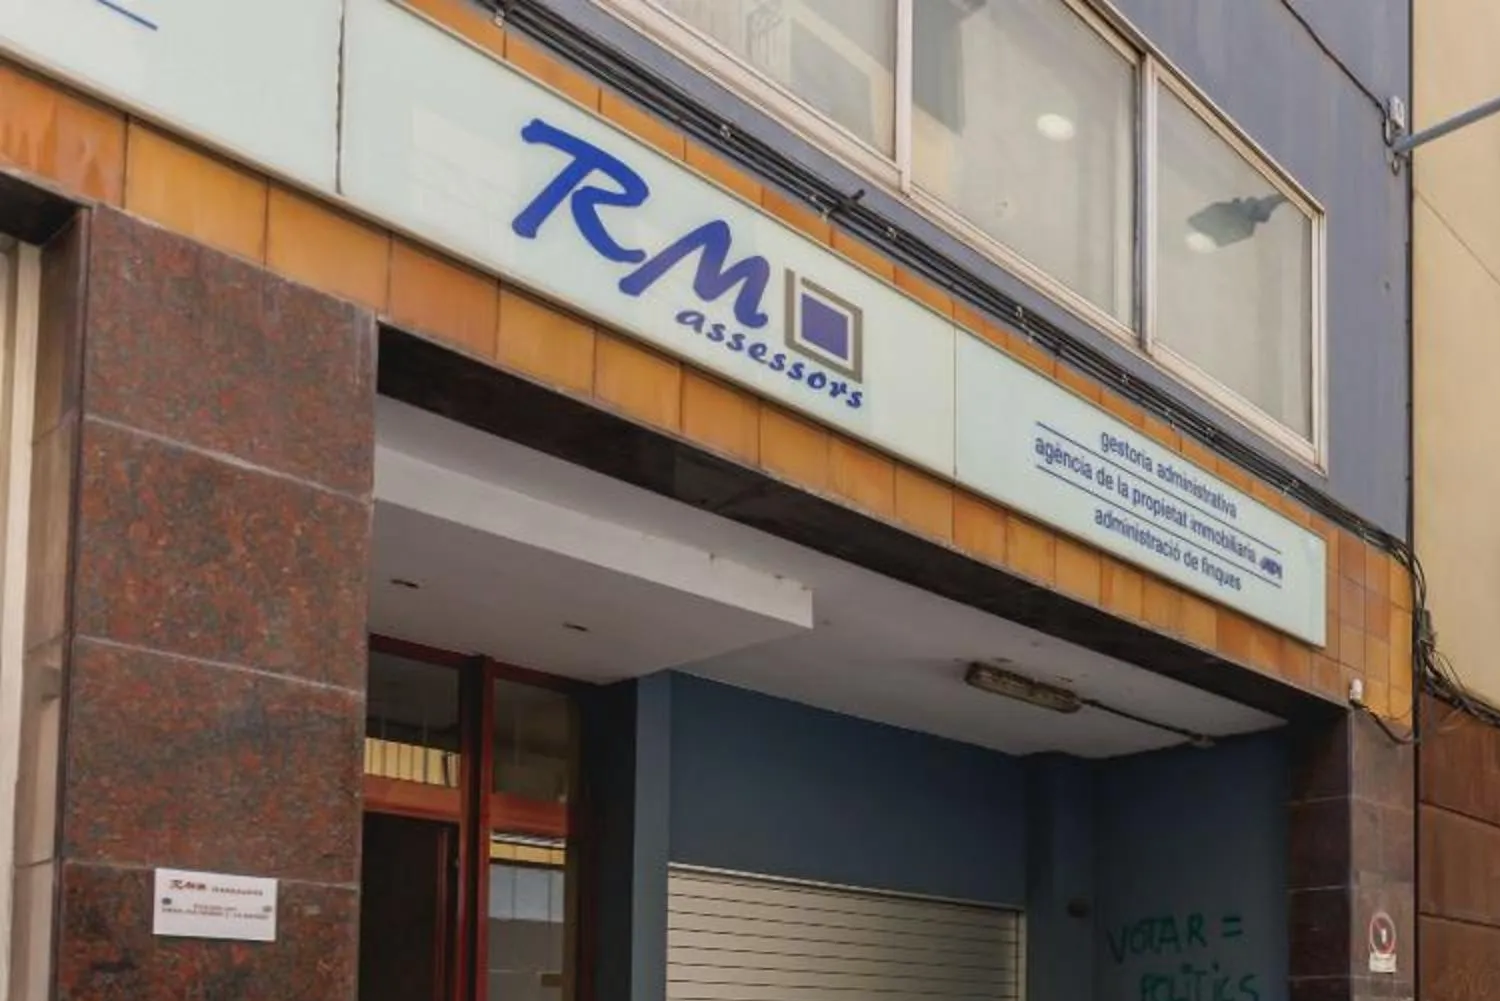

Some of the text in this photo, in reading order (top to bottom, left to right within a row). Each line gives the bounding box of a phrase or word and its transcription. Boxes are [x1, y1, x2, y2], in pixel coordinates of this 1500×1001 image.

[512, 118, 770, 329] RM
[675, 310, 864, 409] assessors
[1034, 436, 1093, 484] agència
[1096, 467, 1114, 490] de
[1117, 475, 1129, 497] la
[1132, 486, 1187, 530] propietat
[1100, 431, 1237, 519] gestoria administrativa
[1094, 508, 1242, 591] administració de finques
[1106, 913, 1207, 964] VOTAR
